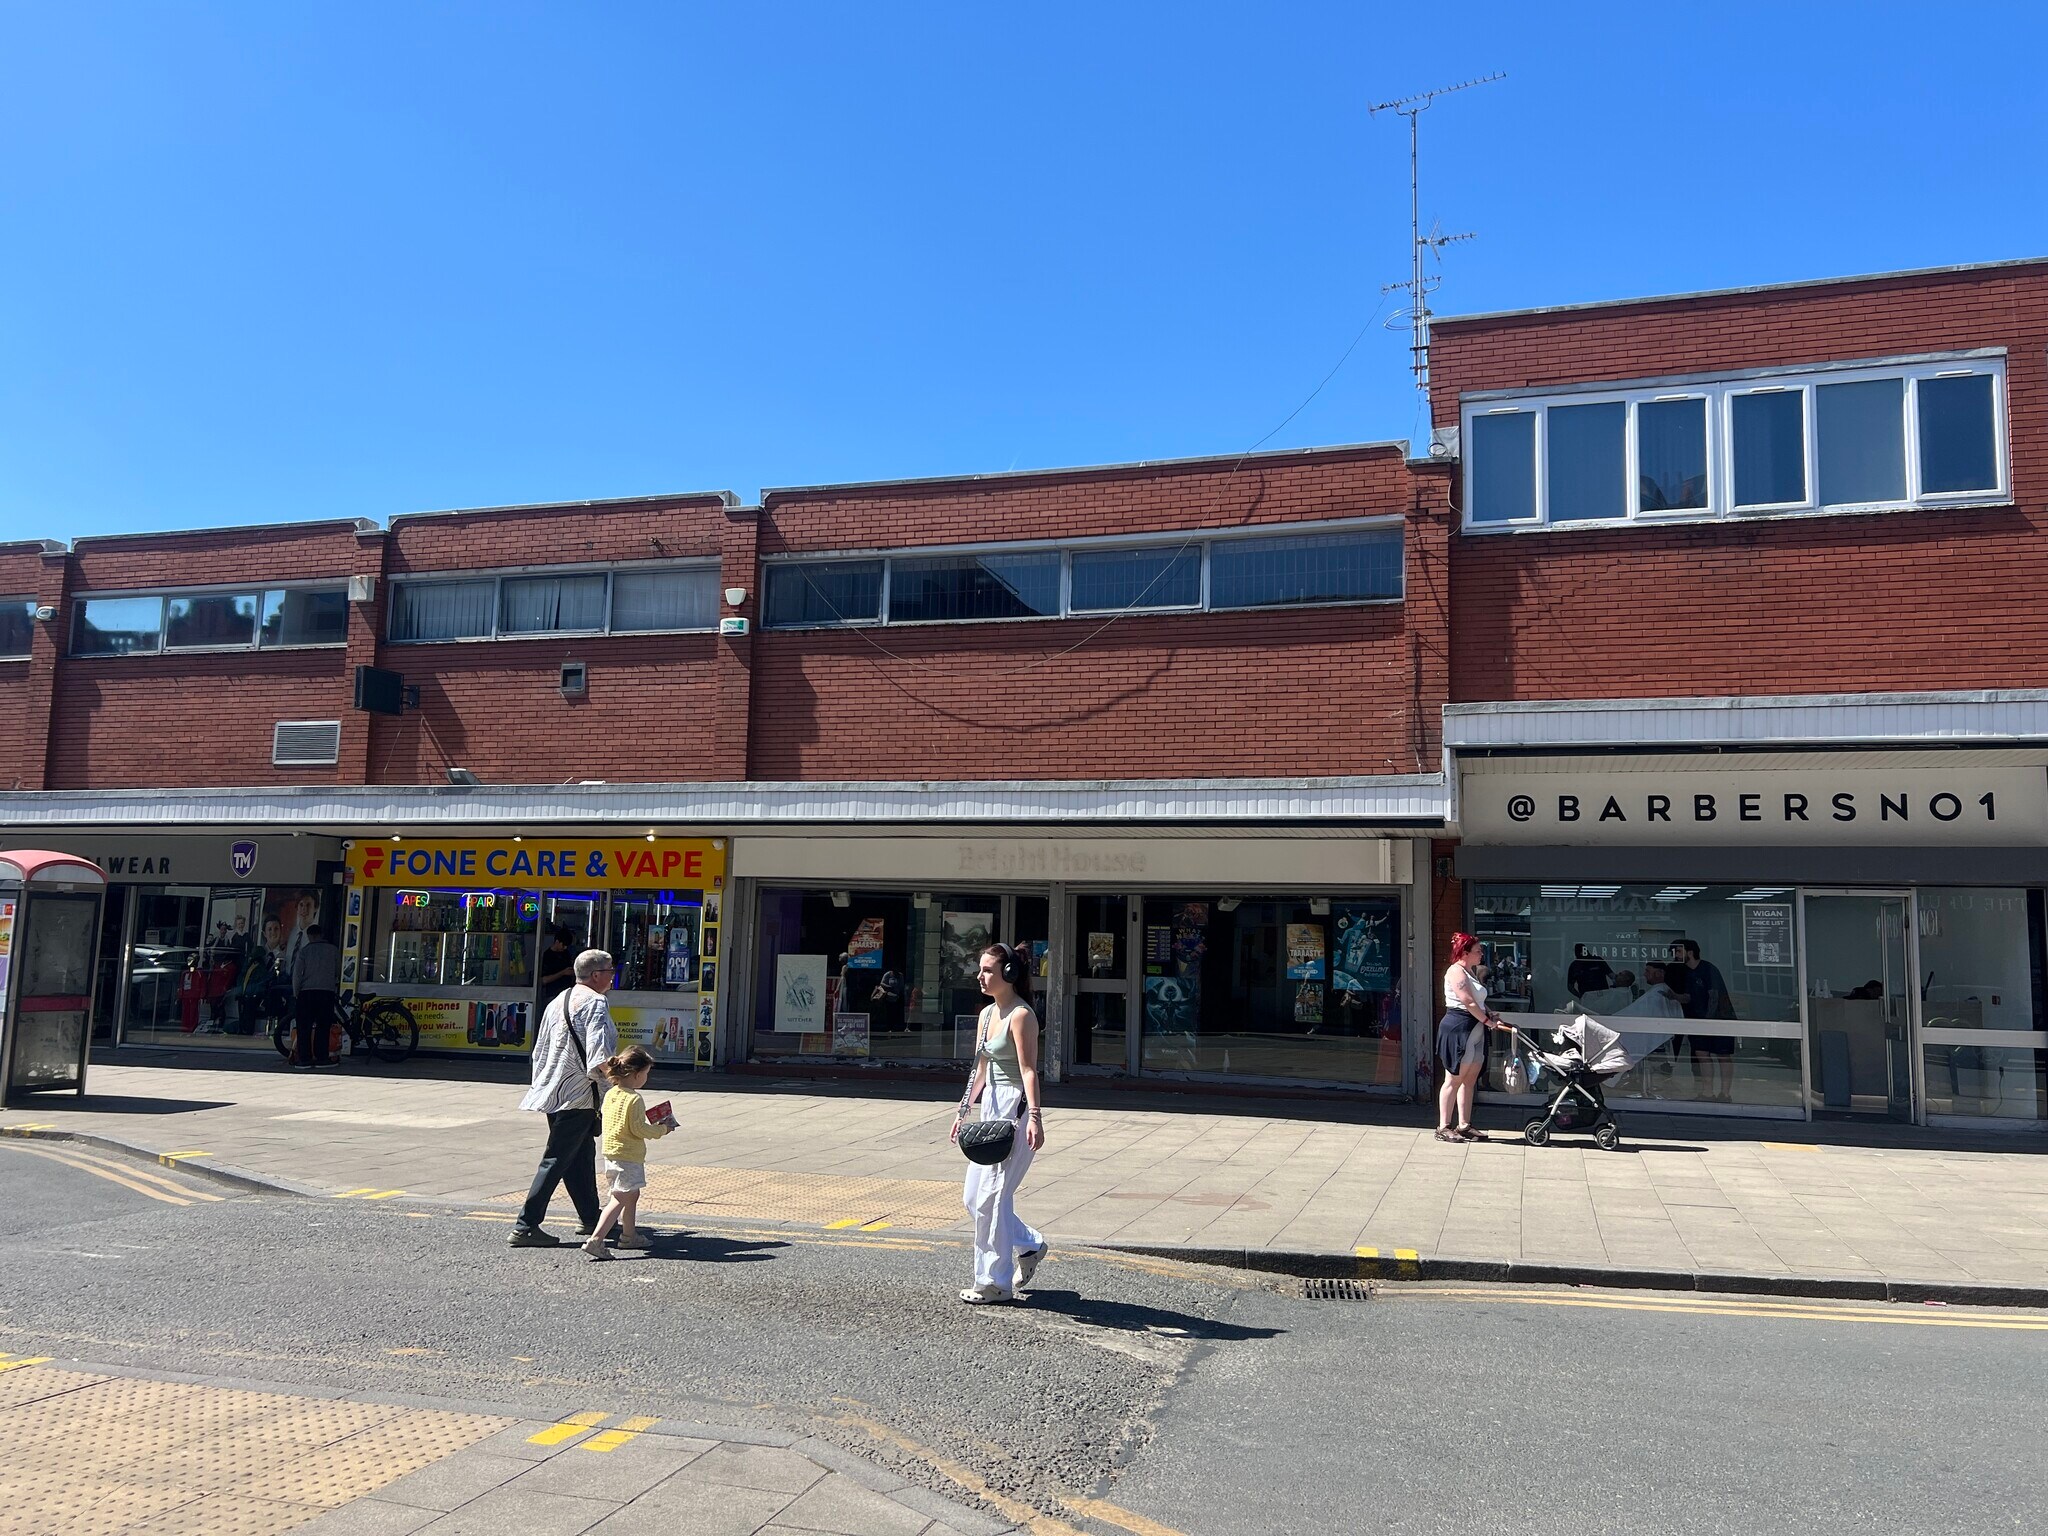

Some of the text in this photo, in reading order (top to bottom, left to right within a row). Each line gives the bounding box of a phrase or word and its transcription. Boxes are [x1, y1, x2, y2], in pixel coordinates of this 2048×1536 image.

[233, 847, 254, 870] TM
[389, 849, 703, 878] FONE CARE & VAPE
[396, 894, 428, 908] VAPES
[520, 902, 540, 912] OPEN
[1752, 909, 1783, 917] WIGAN
[1581, 944, 1676, 960] BARBERSNO1
[407, 1002, 460, 1012] Sell Phones
[418, 1023, 434, 1032] you
[435, 1021, 464, 1031] wait...
[961, 1068, 977, 1108] VALENTINO
